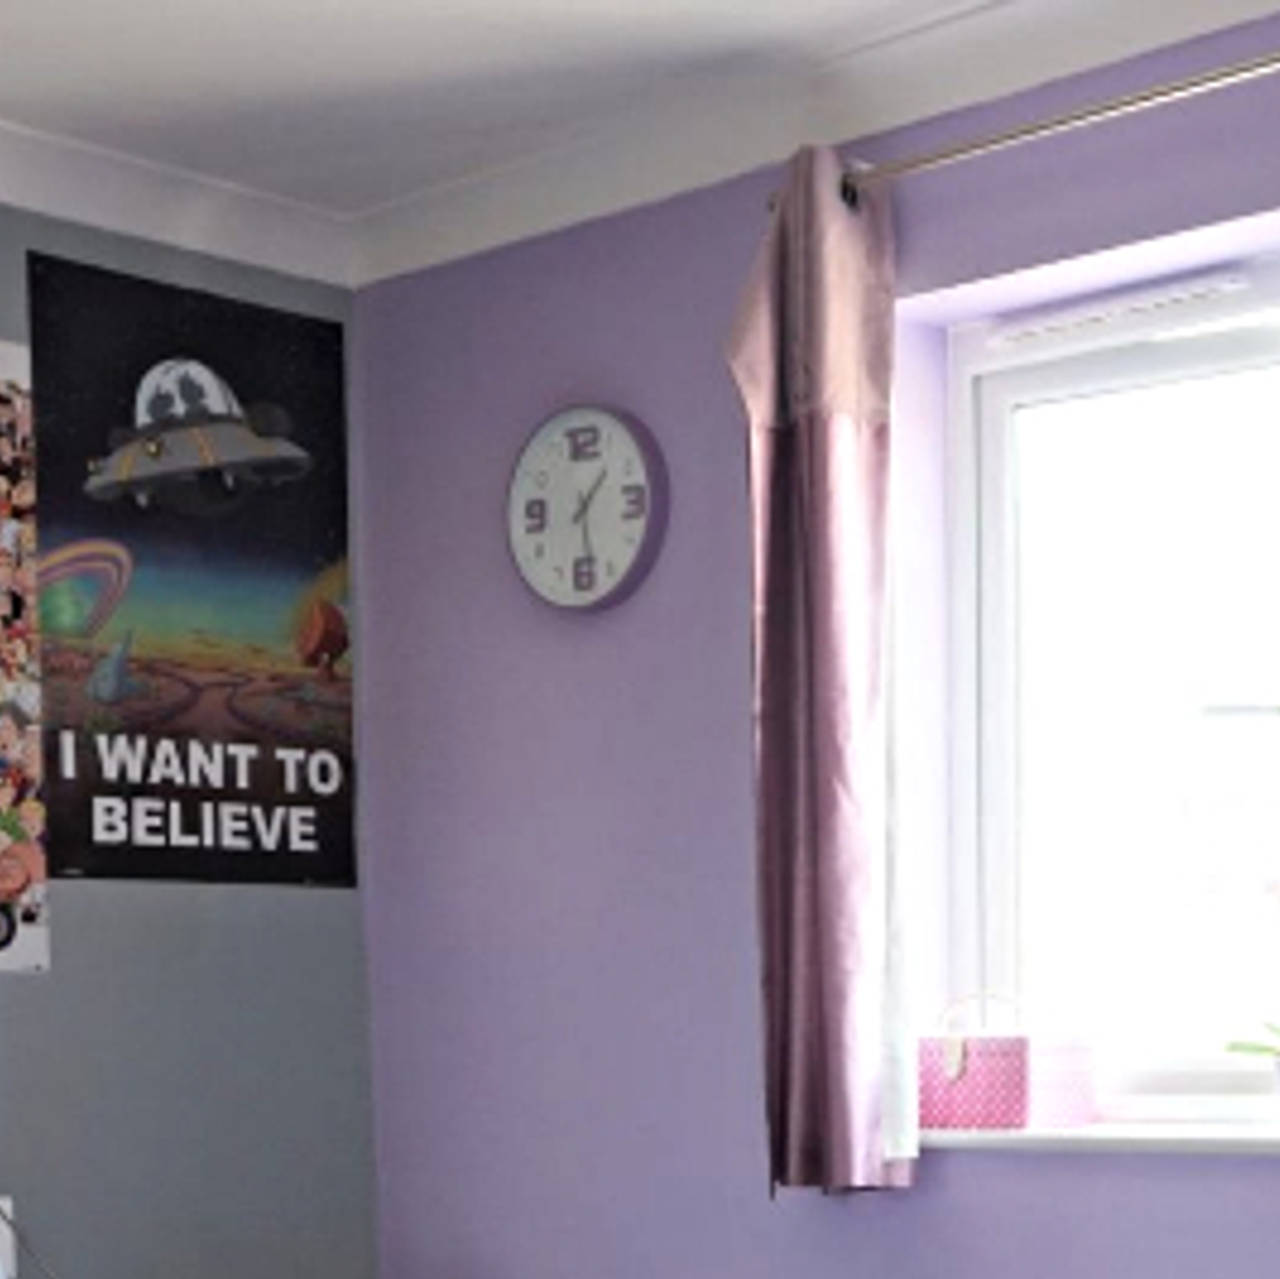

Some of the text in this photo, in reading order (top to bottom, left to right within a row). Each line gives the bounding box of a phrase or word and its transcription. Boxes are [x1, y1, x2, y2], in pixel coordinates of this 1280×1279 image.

[563, 425, 602, 463] 12
[524, 497, 547, 535] 9
[620, 484, 646, 521] 3
[572, 555, 596, 592] 6
[59, 729, 342, 795] I WANT TO
[92, 796, 318, 852] BELIEVE
